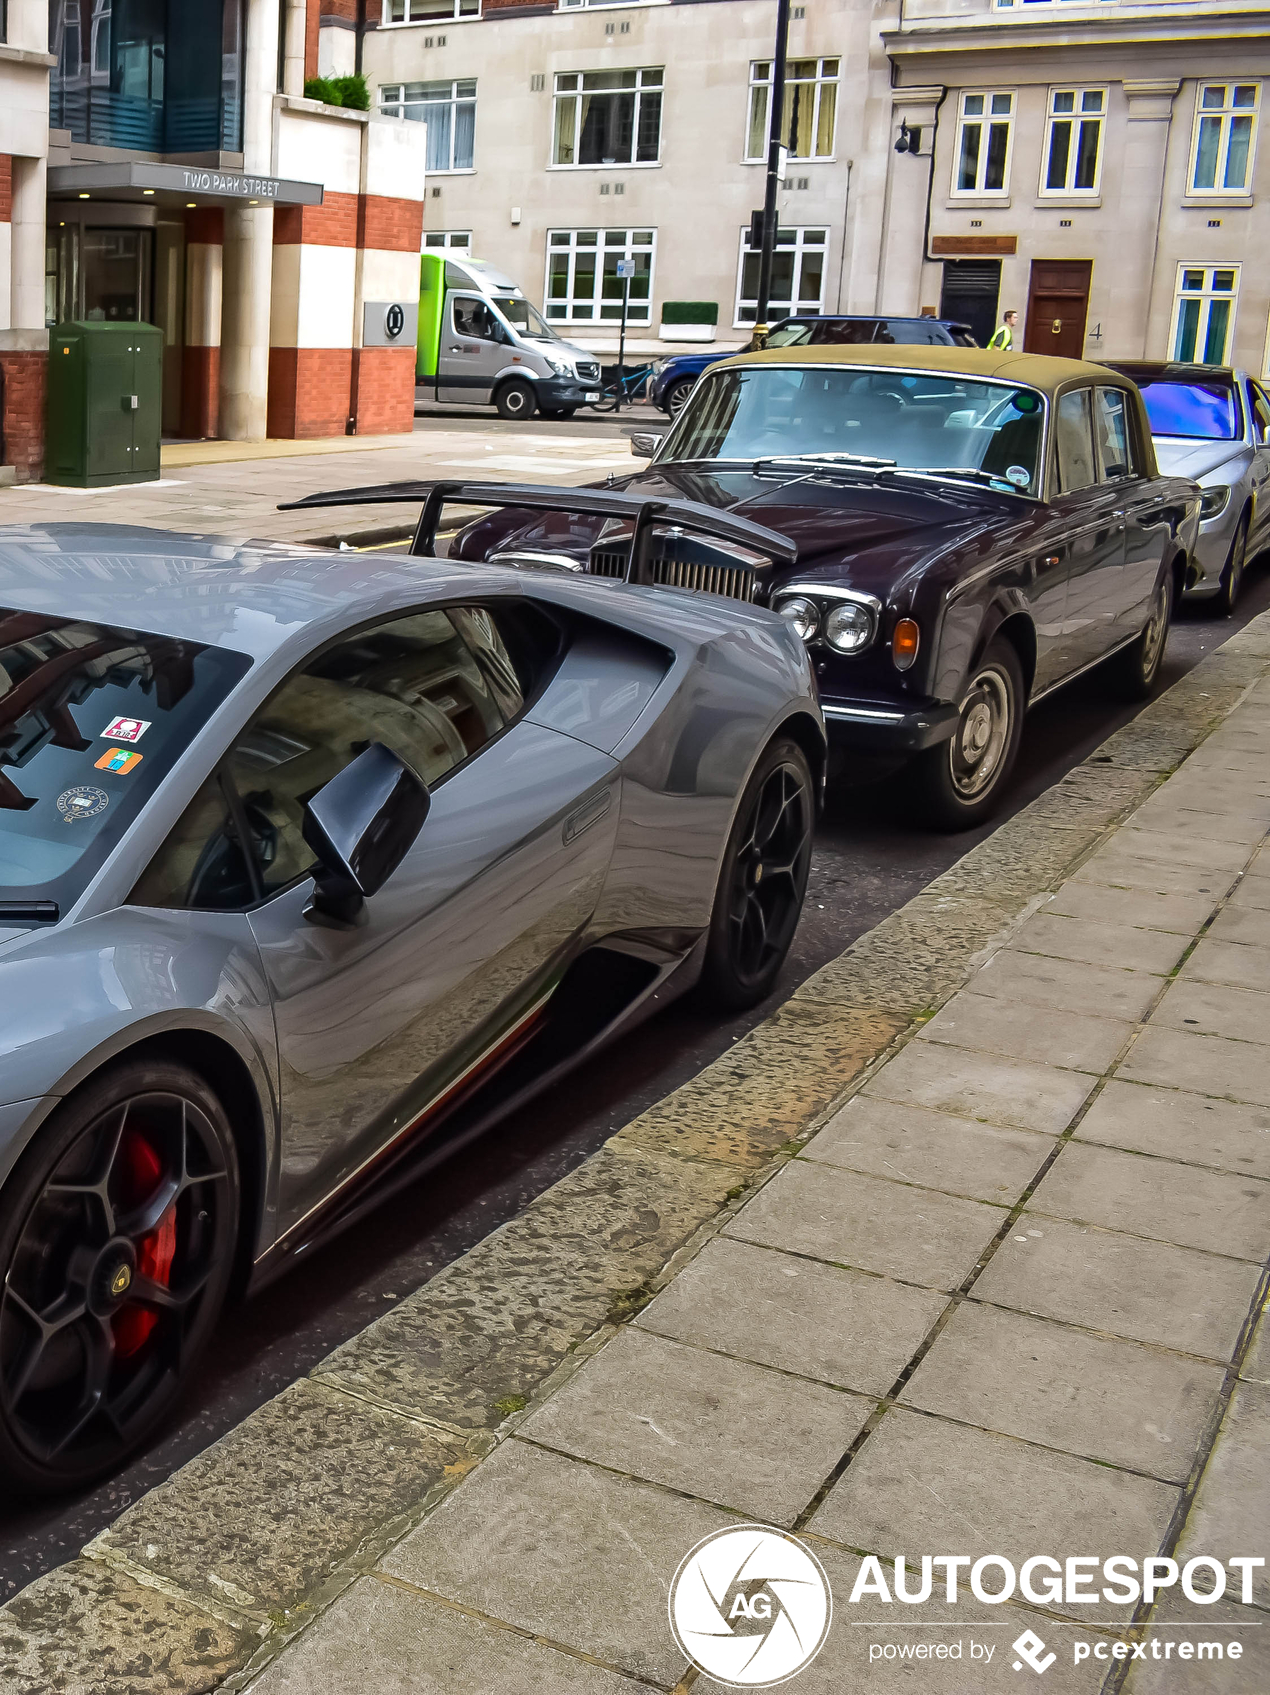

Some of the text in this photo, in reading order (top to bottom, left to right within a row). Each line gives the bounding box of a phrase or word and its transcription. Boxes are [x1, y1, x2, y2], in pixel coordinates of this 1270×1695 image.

[183, 172, 279, 196] TWO PARK STREET
[1089, 322, 1102, 340] 4
